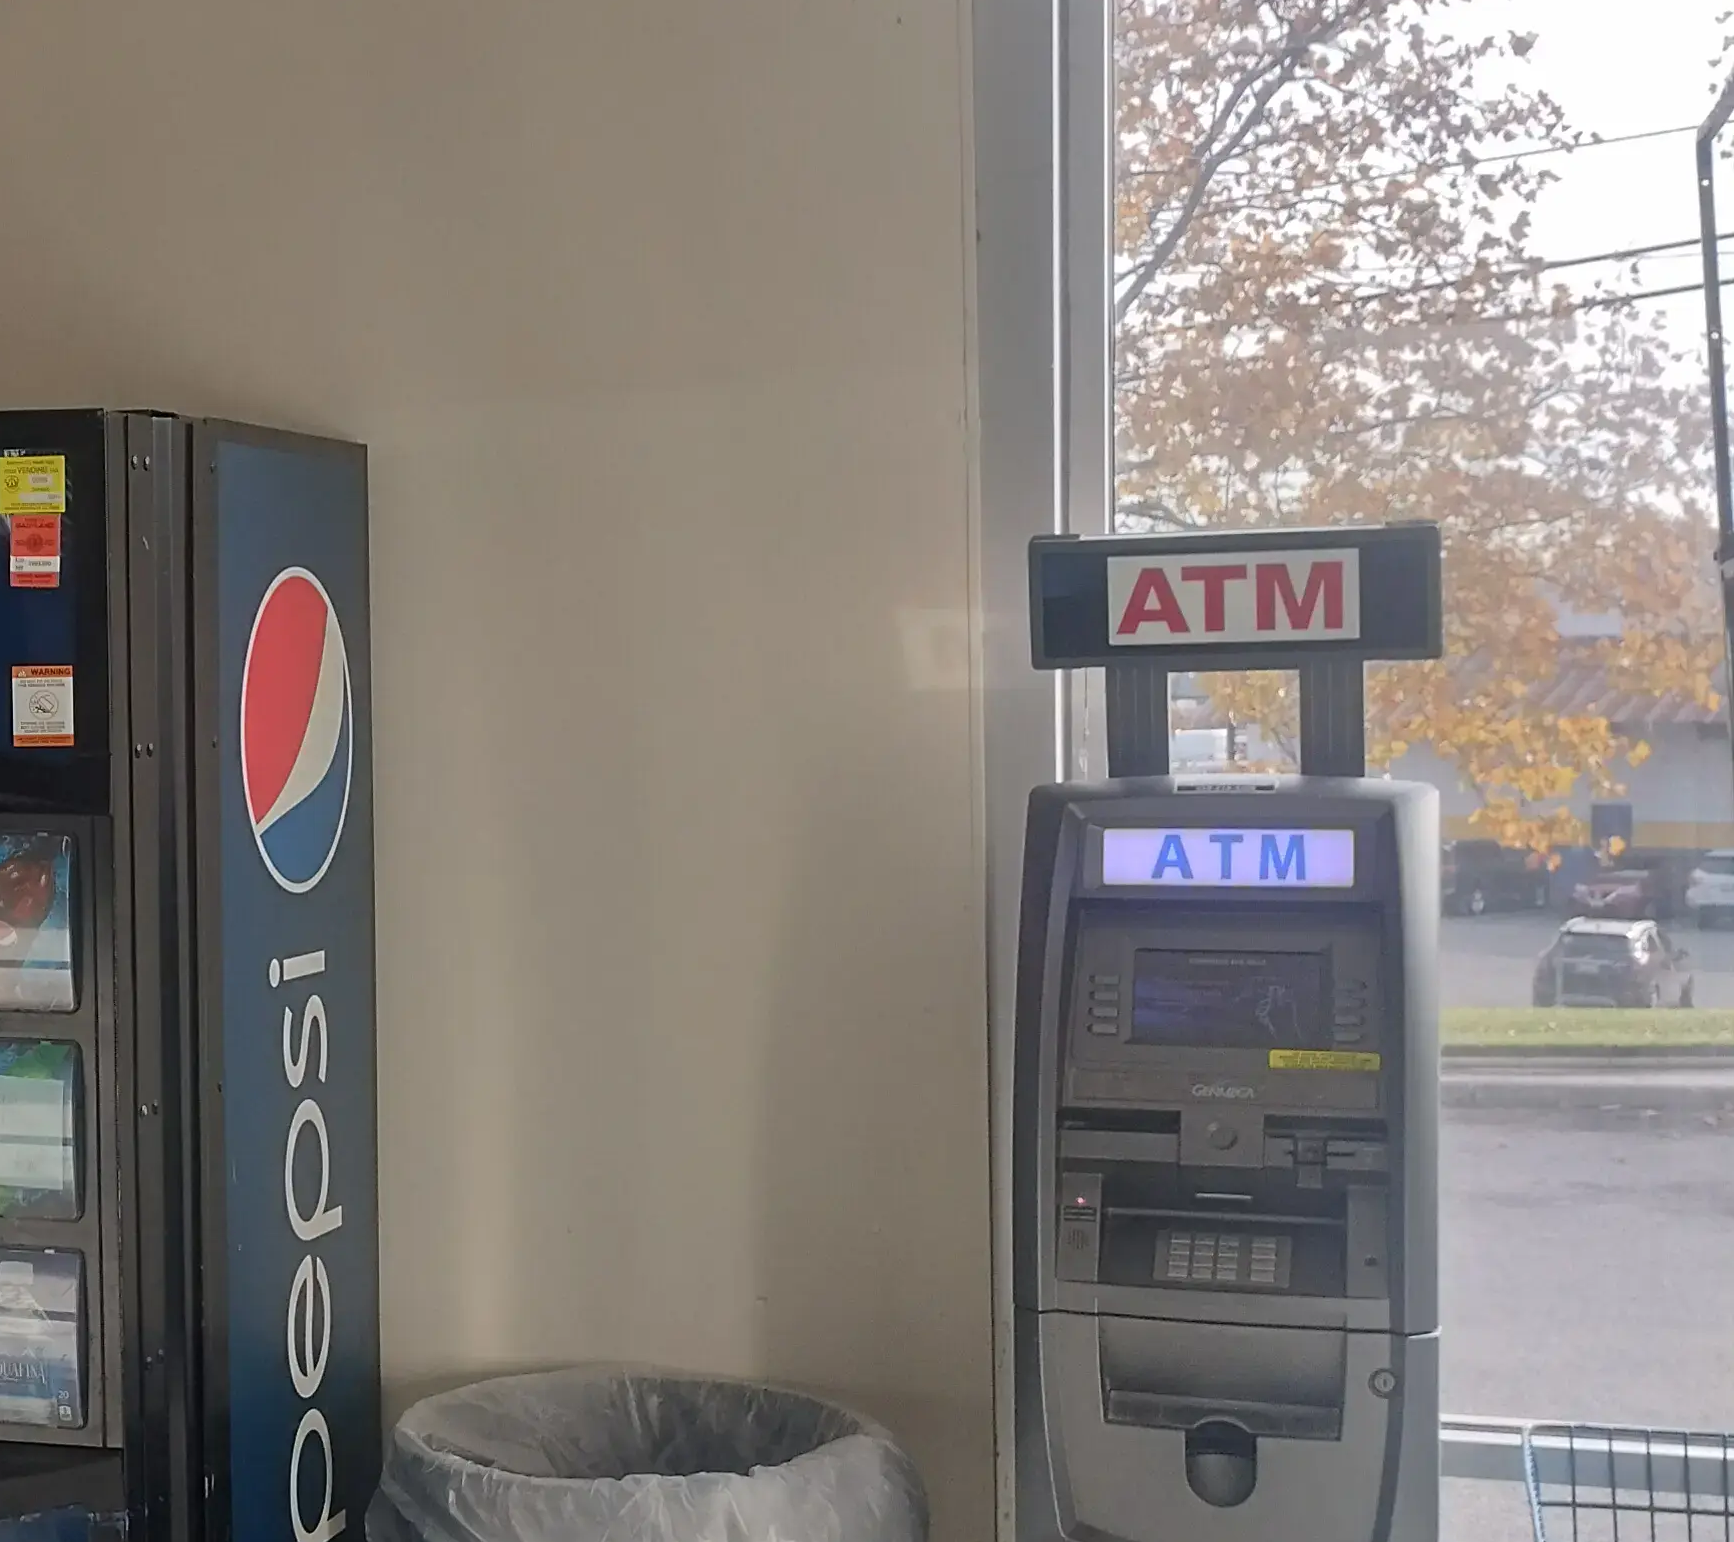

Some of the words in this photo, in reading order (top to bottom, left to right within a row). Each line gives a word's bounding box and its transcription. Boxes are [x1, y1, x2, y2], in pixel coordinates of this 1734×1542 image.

[1116, 560, 1344, 635] ATM
[30, 668, 71, 676] WARNING
[1150, 833, 1306, 880] ATM
